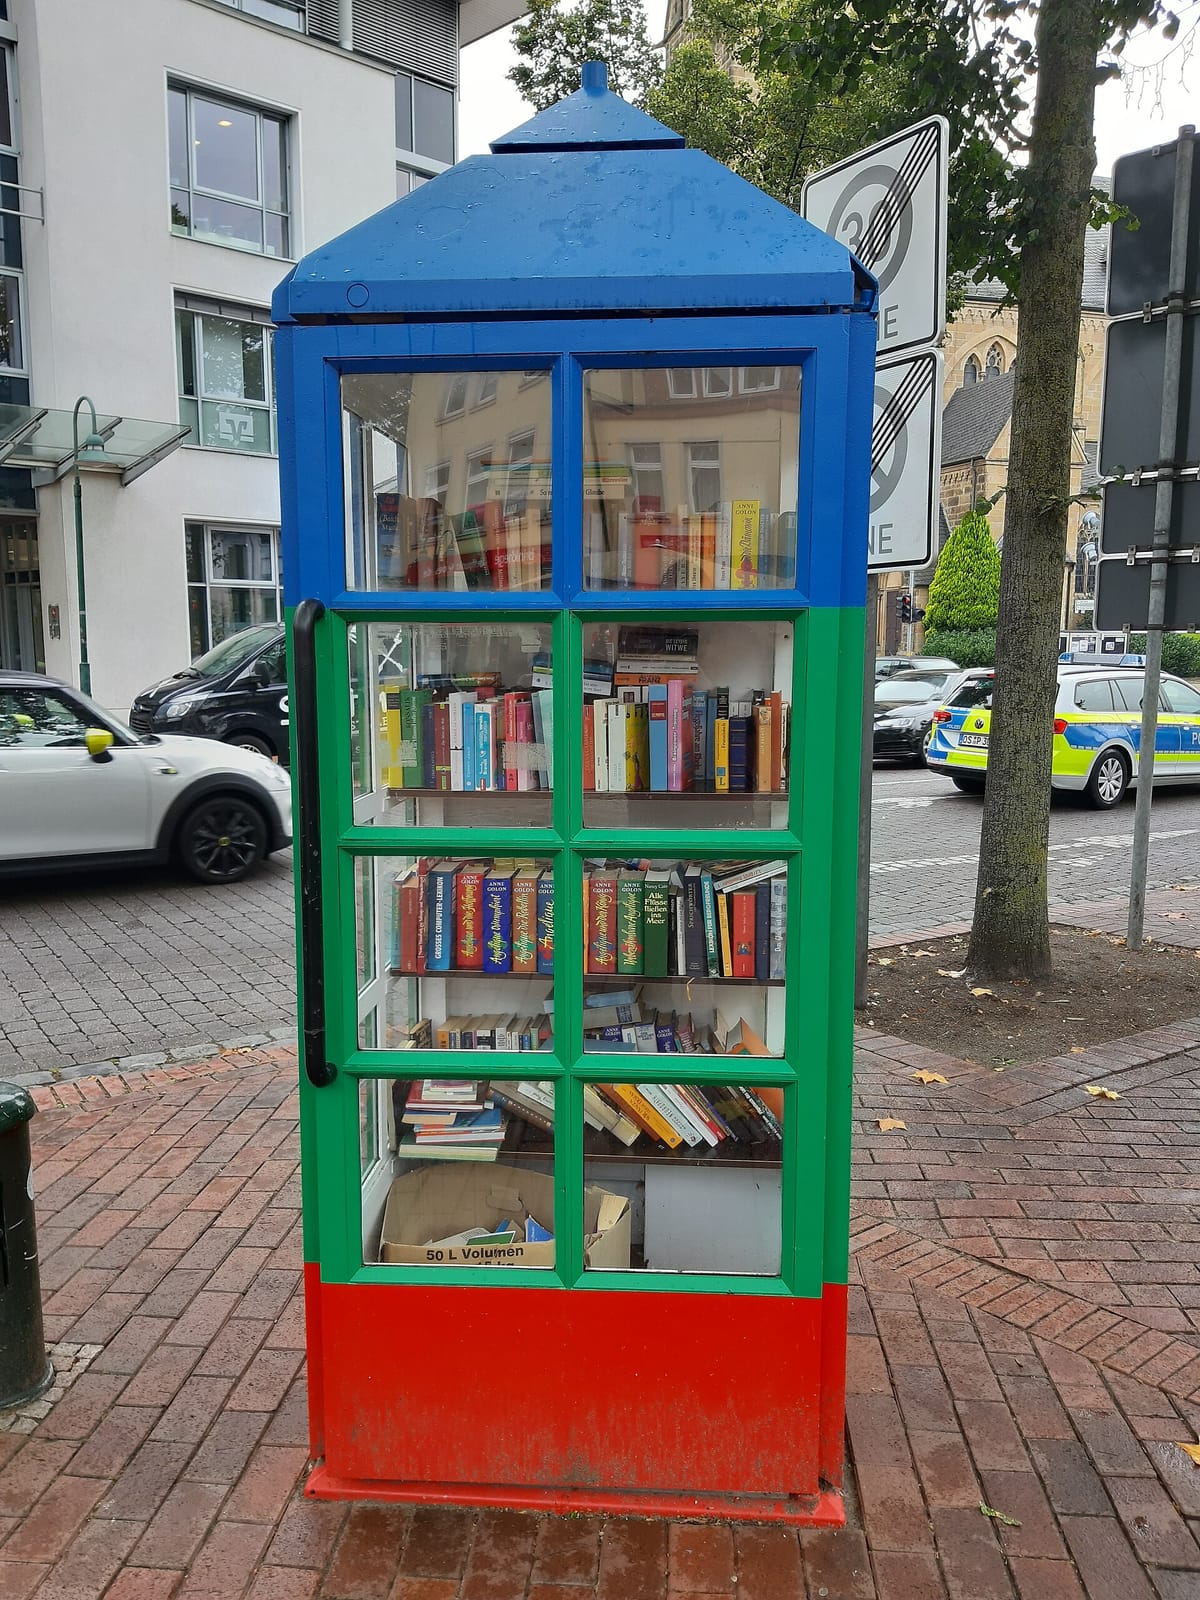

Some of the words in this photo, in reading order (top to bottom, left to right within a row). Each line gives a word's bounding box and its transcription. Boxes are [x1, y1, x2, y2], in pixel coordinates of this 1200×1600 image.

[963, 736, 972, 744] OS
[435, 876, 444, 933] COMPUTER-LEXIKON
[515, 893, 528, 919] Rebellin
[704, 881, 713, 918] BERGFREUNDE
[705, 920, 713, 929] FÜR
[705, 930, 715, 953] LEXIKON
[426, 1250, 443, 1261] 50
[449, 1249, 457, 1260] L
[462, 1246, 524, 1260] Volumen
